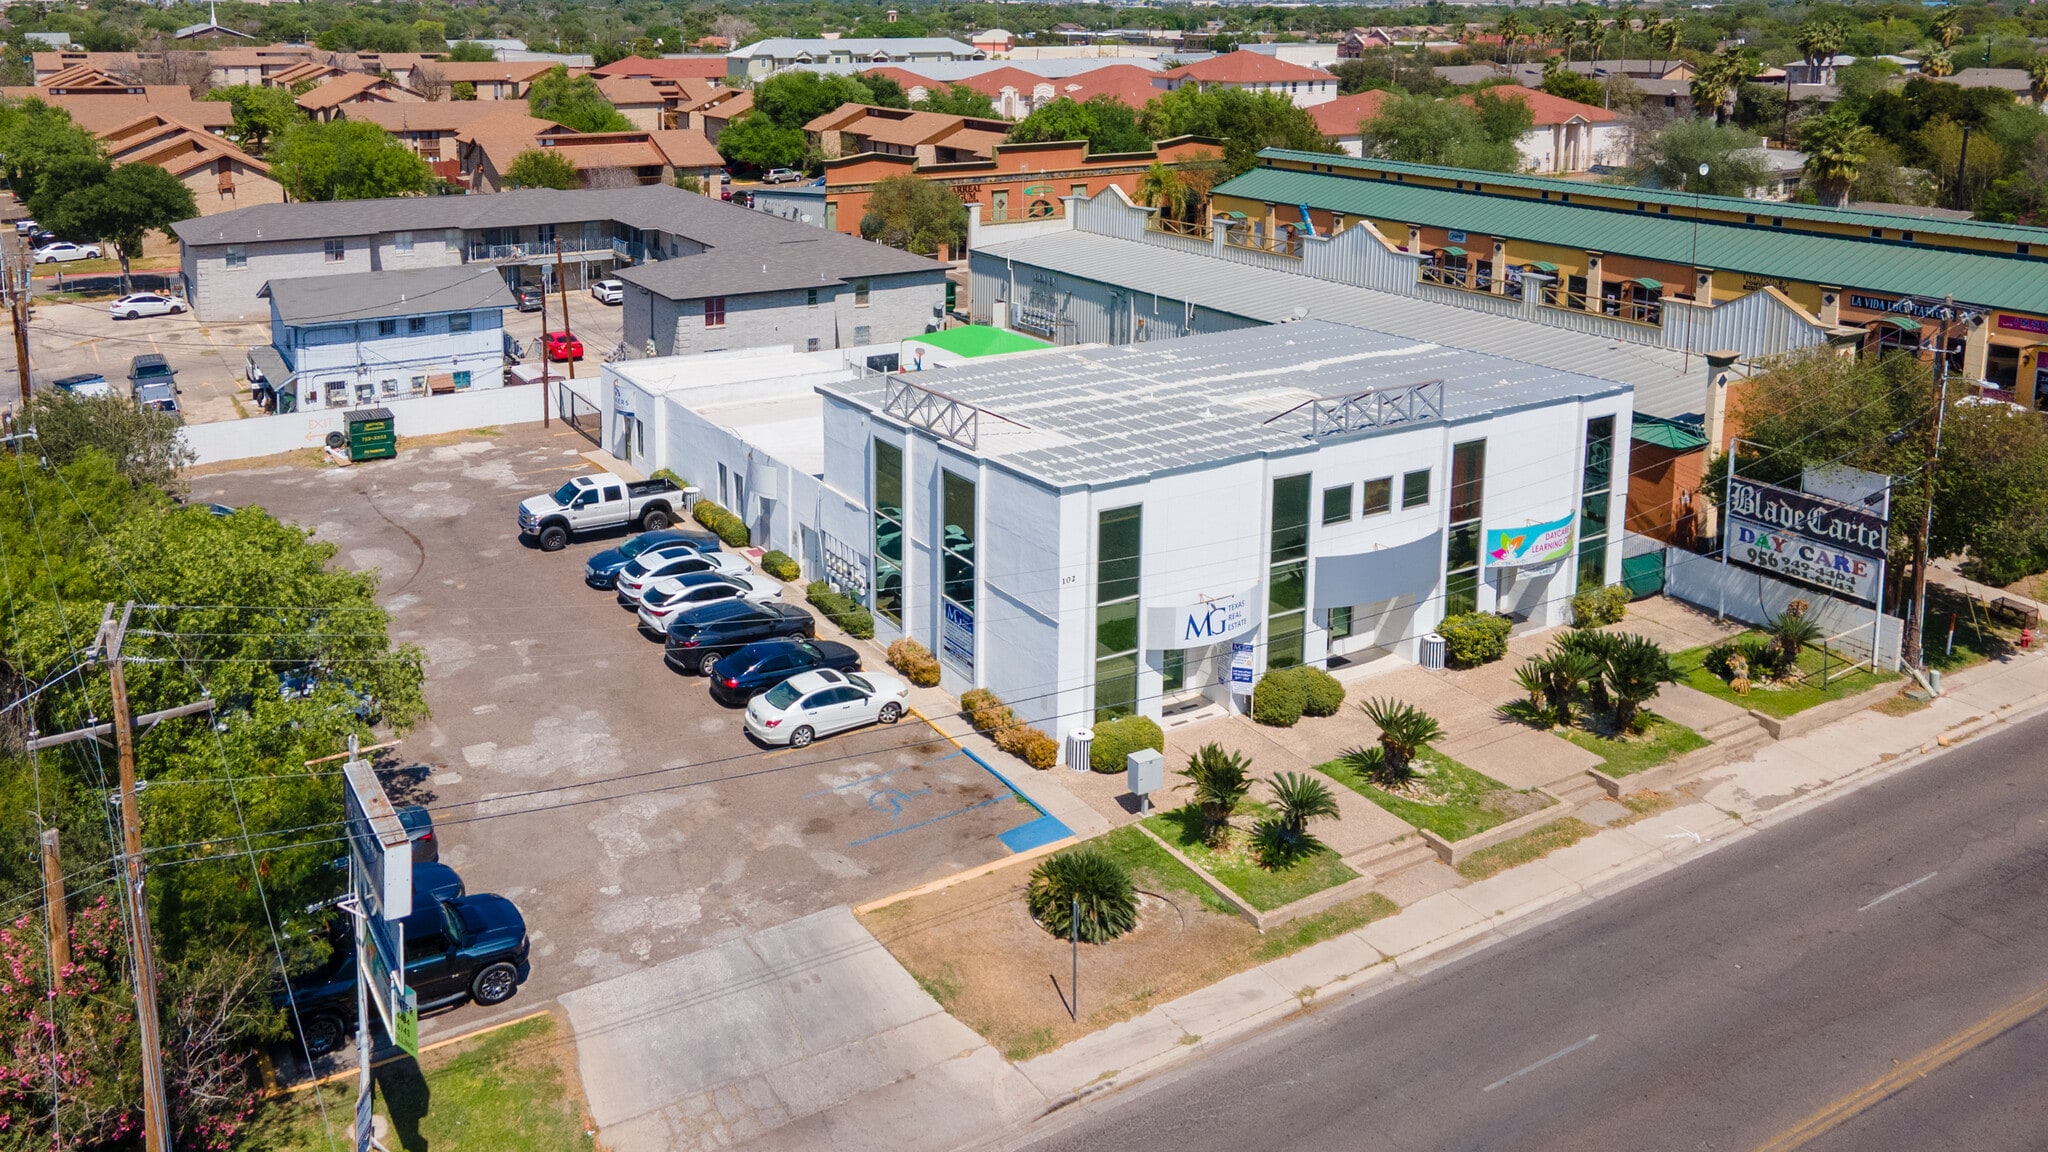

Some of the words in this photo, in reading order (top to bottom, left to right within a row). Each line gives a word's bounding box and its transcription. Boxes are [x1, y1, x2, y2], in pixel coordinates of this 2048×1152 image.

[1851, 296, 1862, 306] LA
[1864, 297, 1885, 310] VIDA
[308, 416, 334, 429] EXIT
[1731, 482, 1805, 530] Blade
[1807, 506, 1889, 554] Cartel
[1531, 539, 1563, 553] LEARNING
[1738, 526, 1788, 553] DAY
[1798, 545, 1868, 578] CARE
[1747, 547, 1779, 568] 956
[1781, 556, 1857, 585] 949-4404
[1062, 575, 1076, 585] 102
[1228, 599, 1246, 612] TEXAS
[1228, 611, 1242, 620] REAL
[1184, 606, 1226, 640] MG
[1228, 617, 1248, 632] ESTATE
